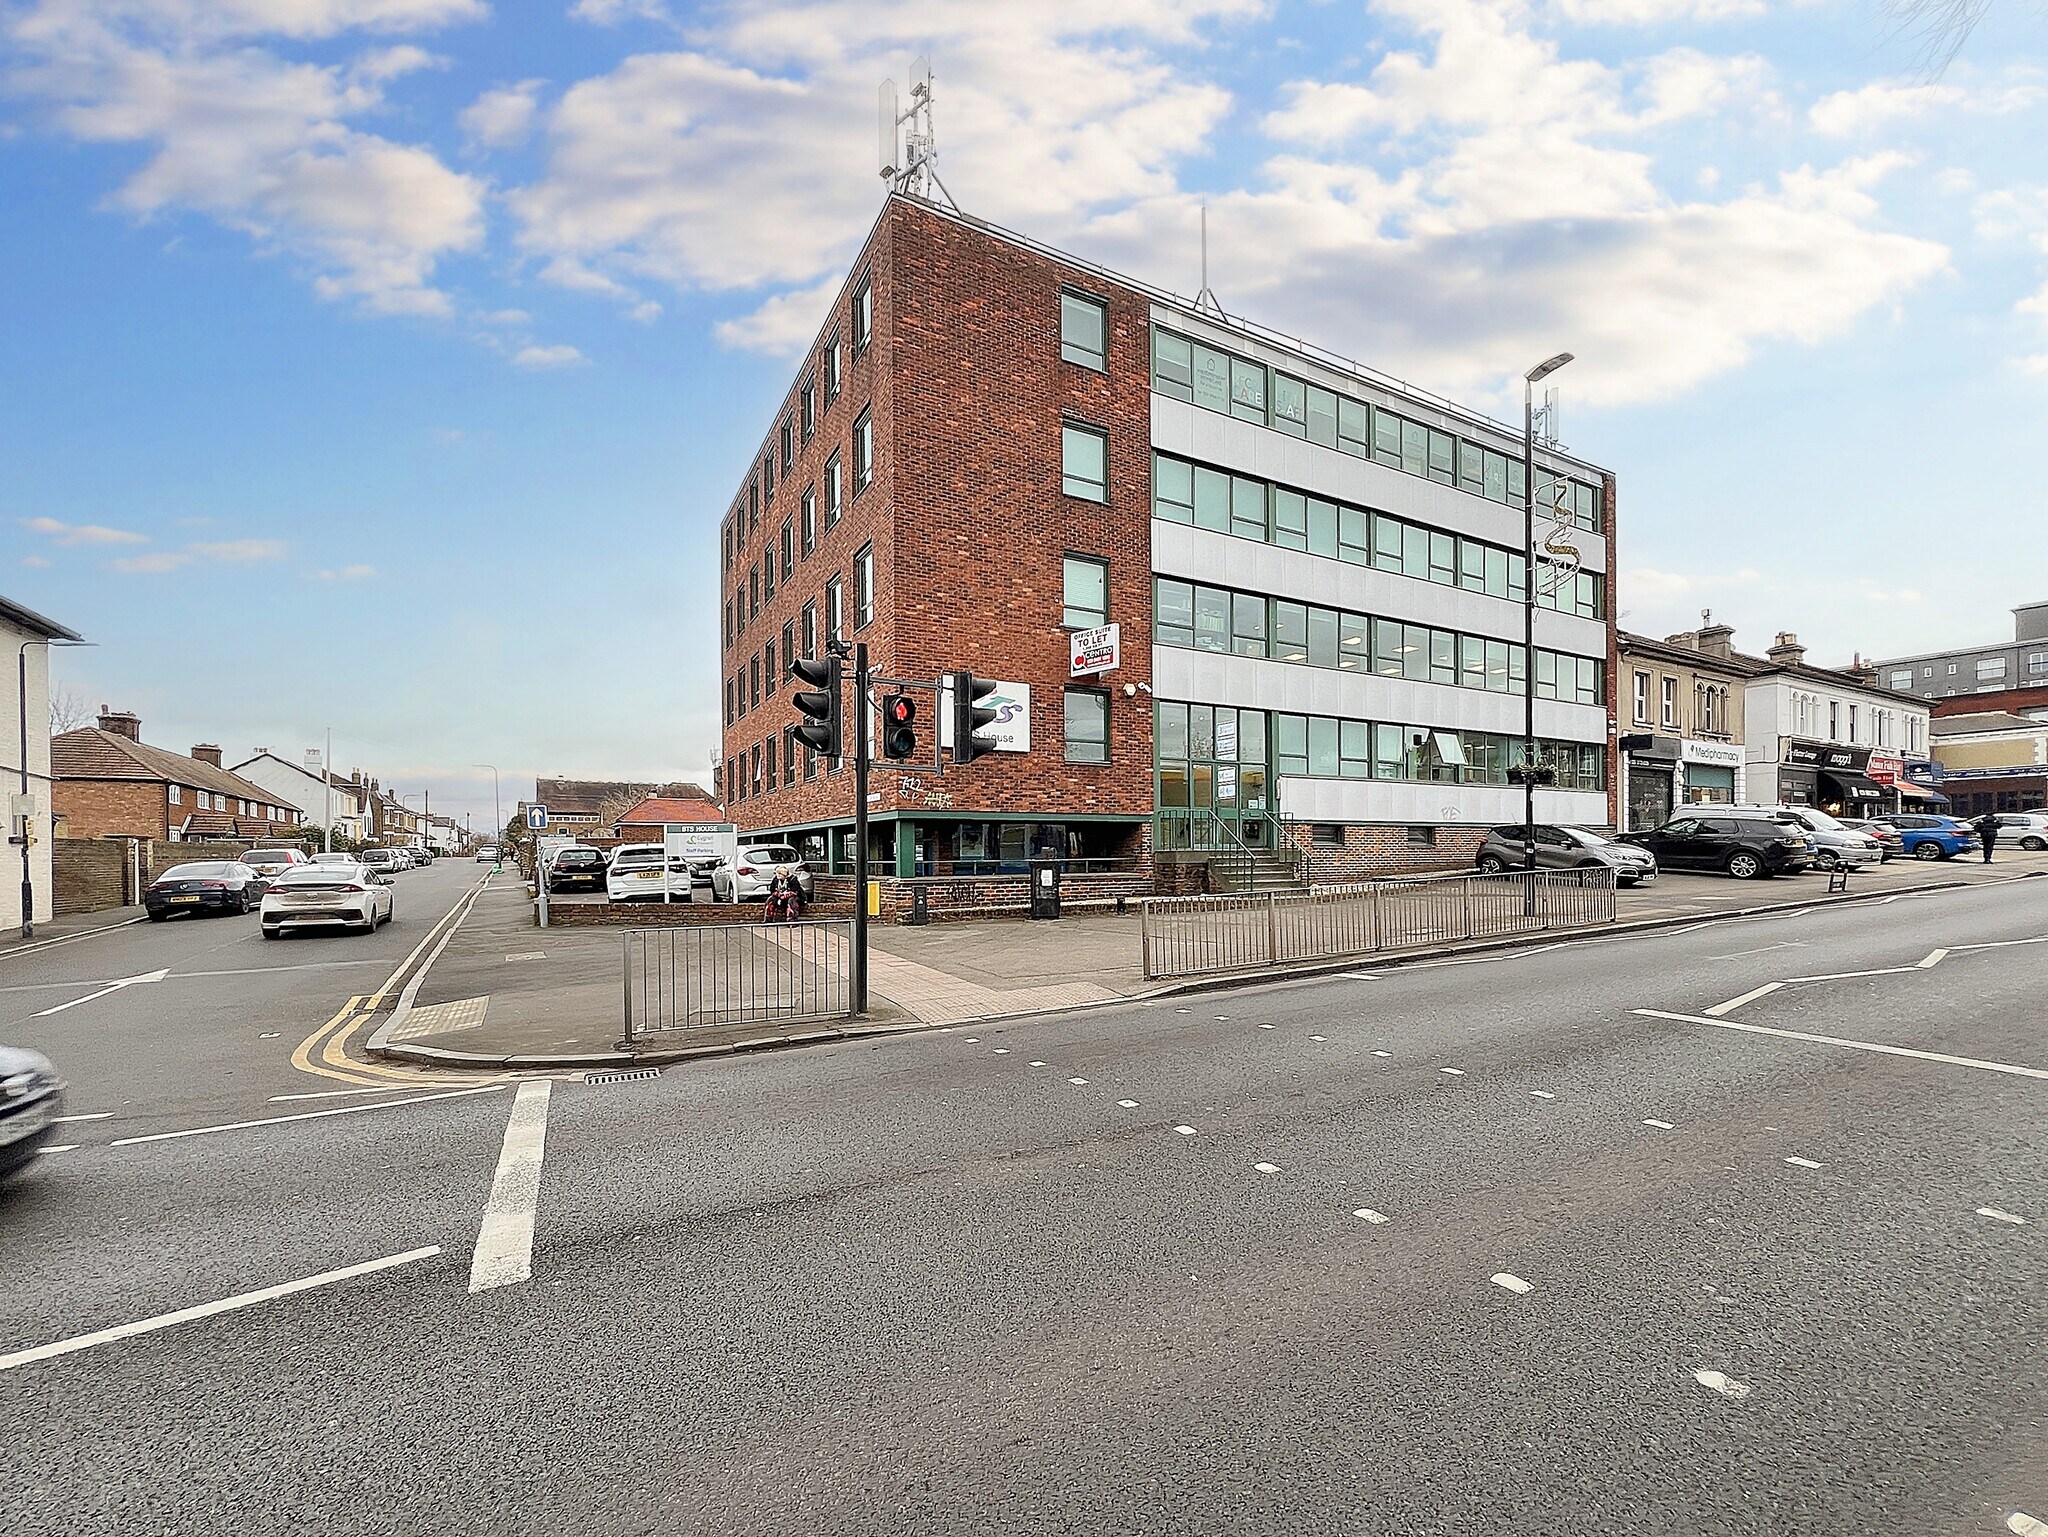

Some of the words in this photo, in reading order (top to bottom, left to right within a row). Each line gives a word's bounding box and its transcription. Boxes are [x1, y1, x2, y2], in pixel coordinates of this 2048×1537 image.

[1074, 631, 1093, 640] OFFICE
[1095, 626, 1111, 635] SUITE
[1078, 639, 1088, 647] TO
[1092, 634, 1107, 644] LET
[1695, 746, 1740, 763] Medipharmacy
